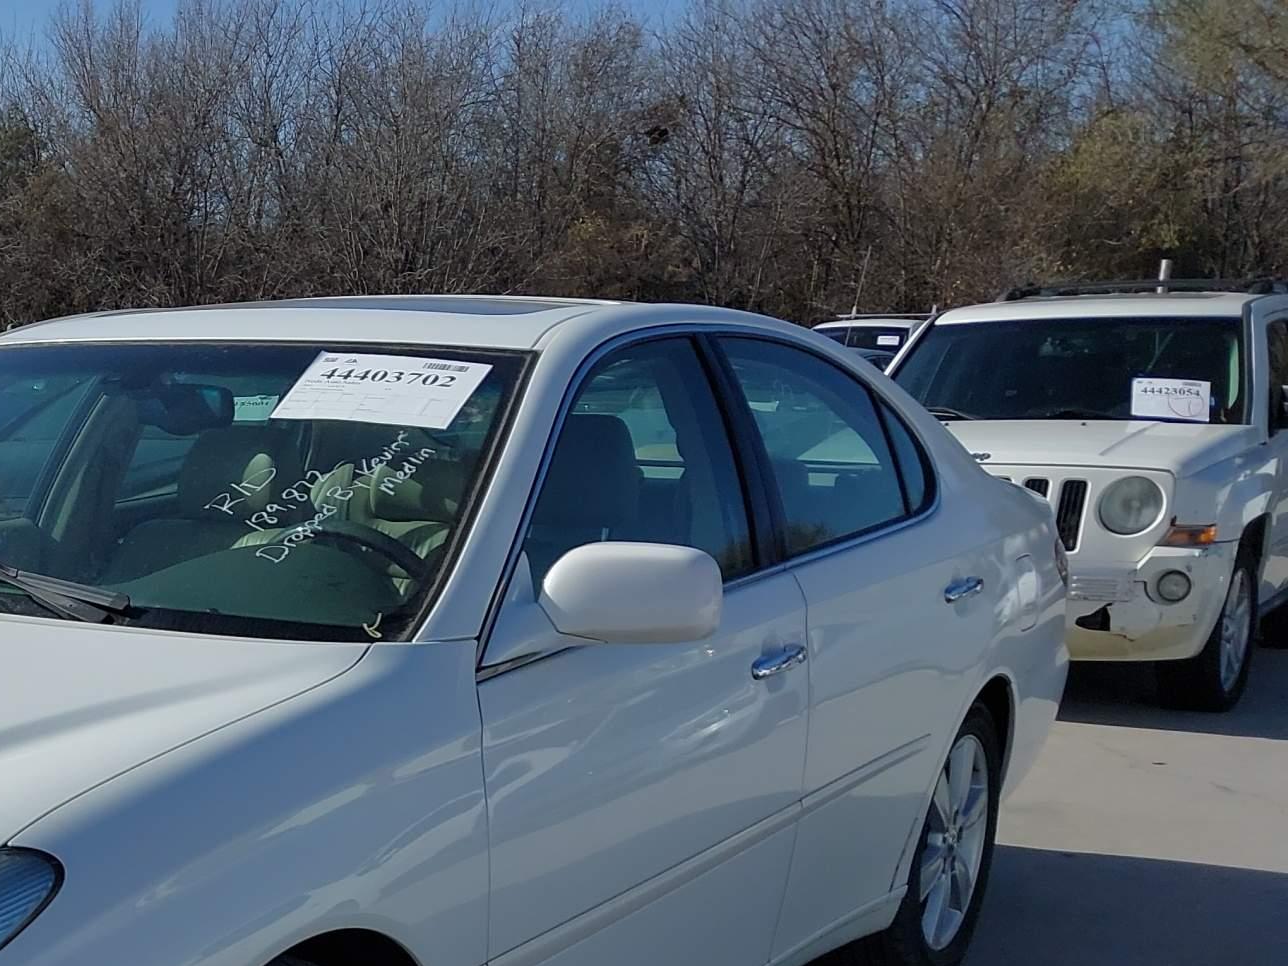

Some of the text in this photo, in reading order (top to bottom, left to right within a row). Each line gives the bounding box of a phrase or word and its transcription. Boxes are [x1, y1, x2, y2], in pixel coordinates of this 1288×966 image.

[320, 367, 457, 389] 44403702
[1140, 386, 1201, 397] 44423054
[378, 448, 436, 496] Medlin
[255, 503, 338, 564] Dropped
